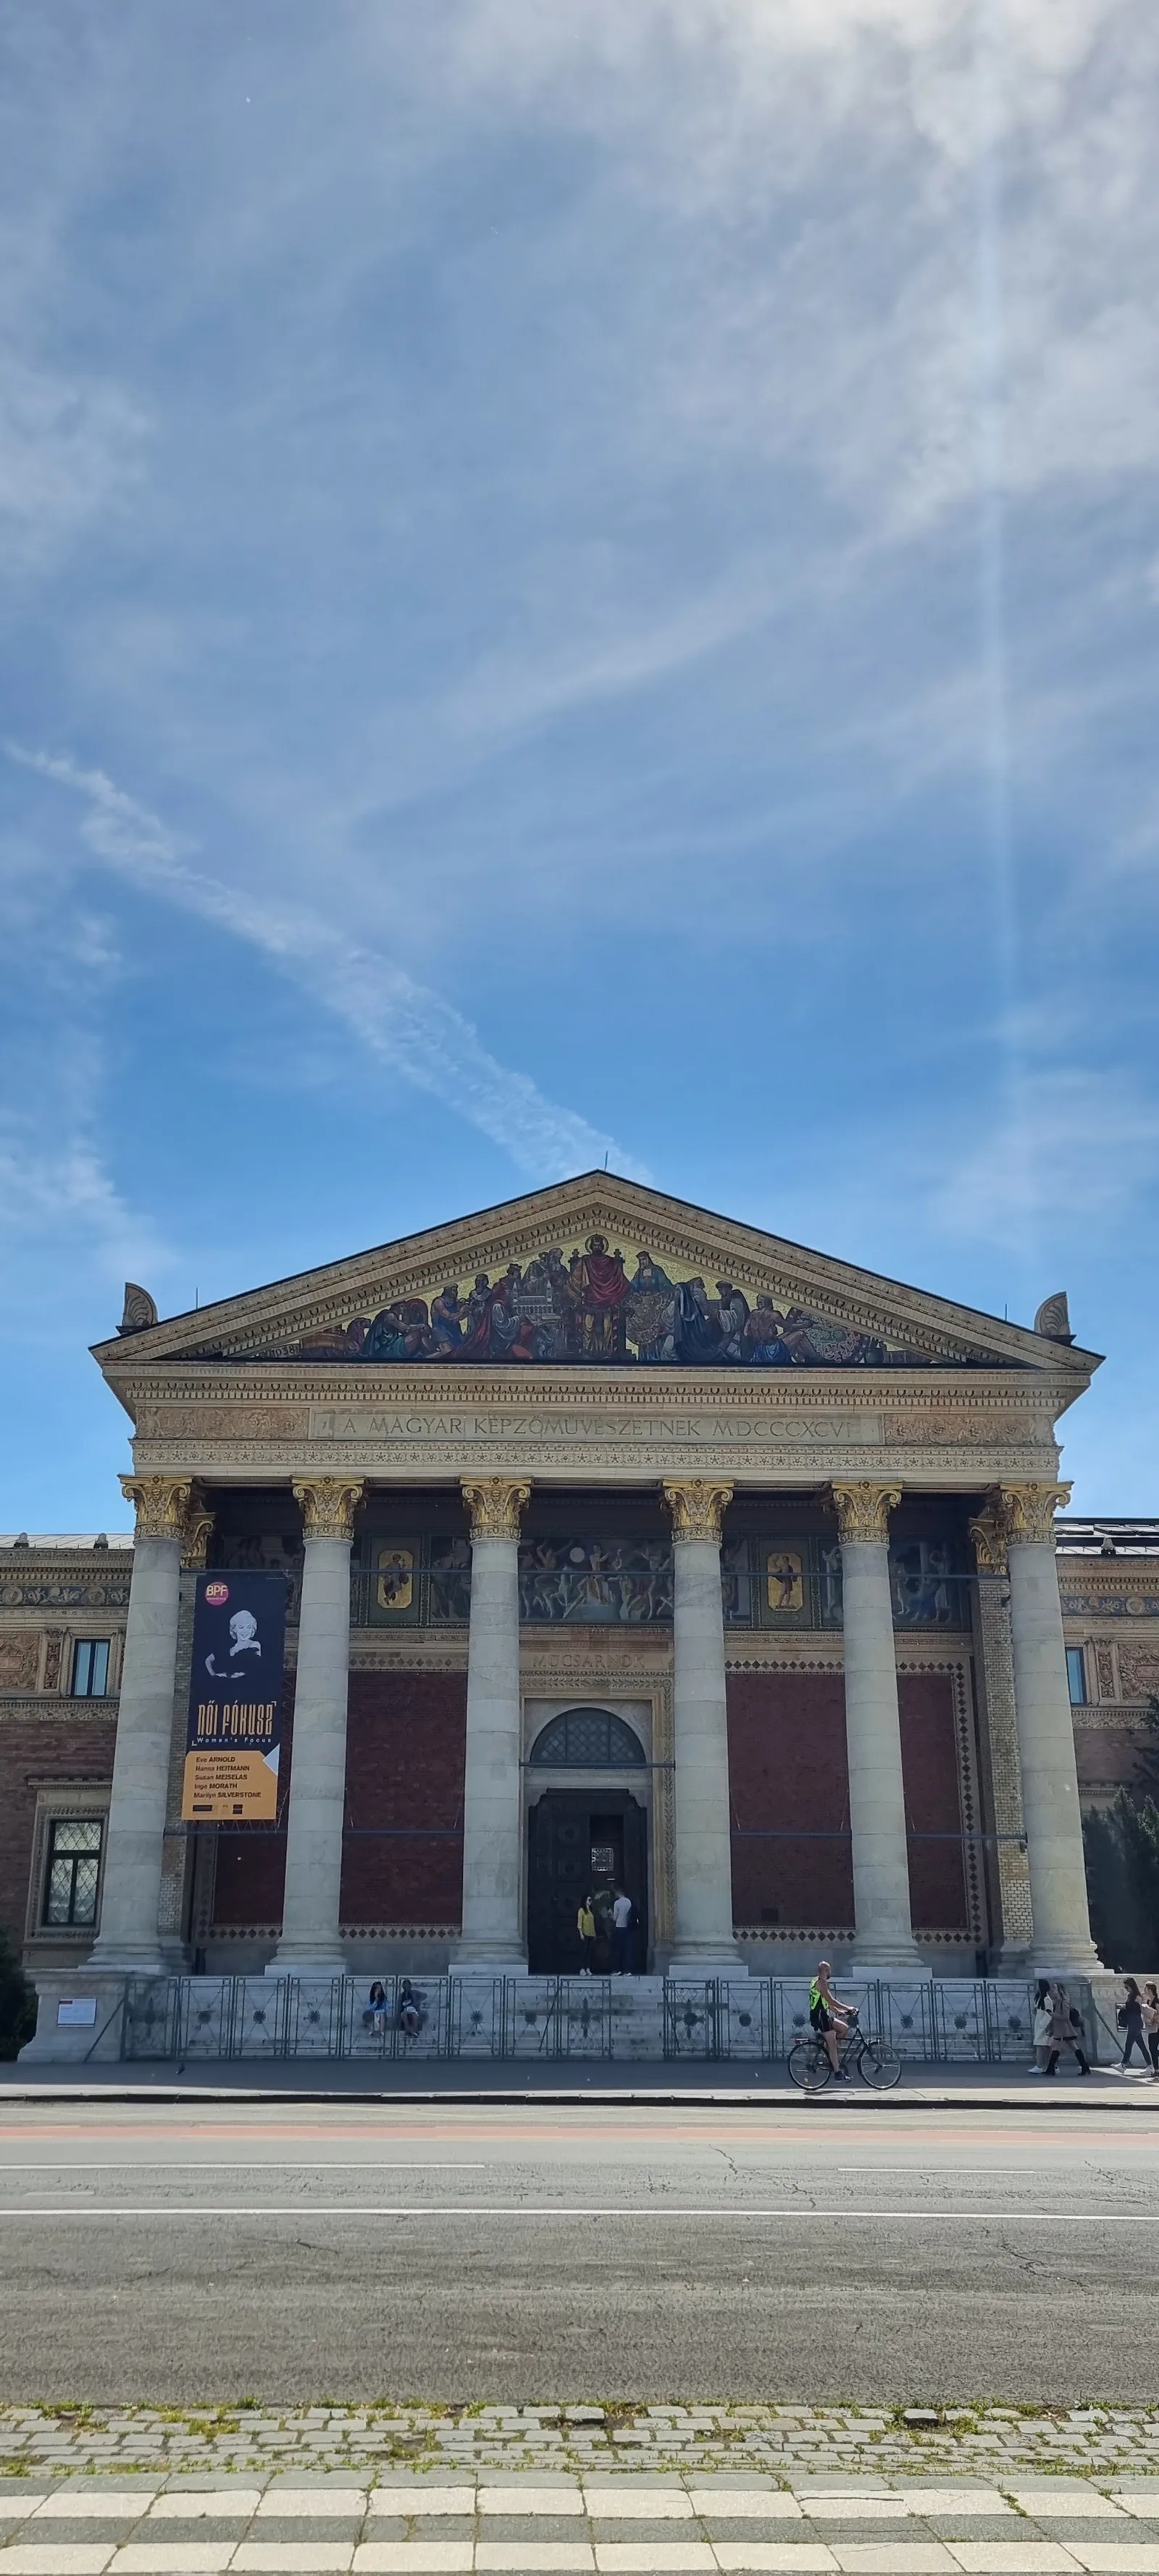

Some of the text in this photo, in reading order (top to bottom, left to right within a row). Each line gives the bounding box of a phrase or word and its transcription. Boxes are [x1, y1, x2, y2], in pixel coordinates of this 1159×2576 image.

[343, 1417, 356, 1433] A
[369, 1417, 462, 1434] MAGYAR
[713, 1420, 850, 1437] MDCCCXCVI
[206, 1584, 228, 1597] BPF
[197, 1699, 273, 1736] NŐI FÓKUSZ
